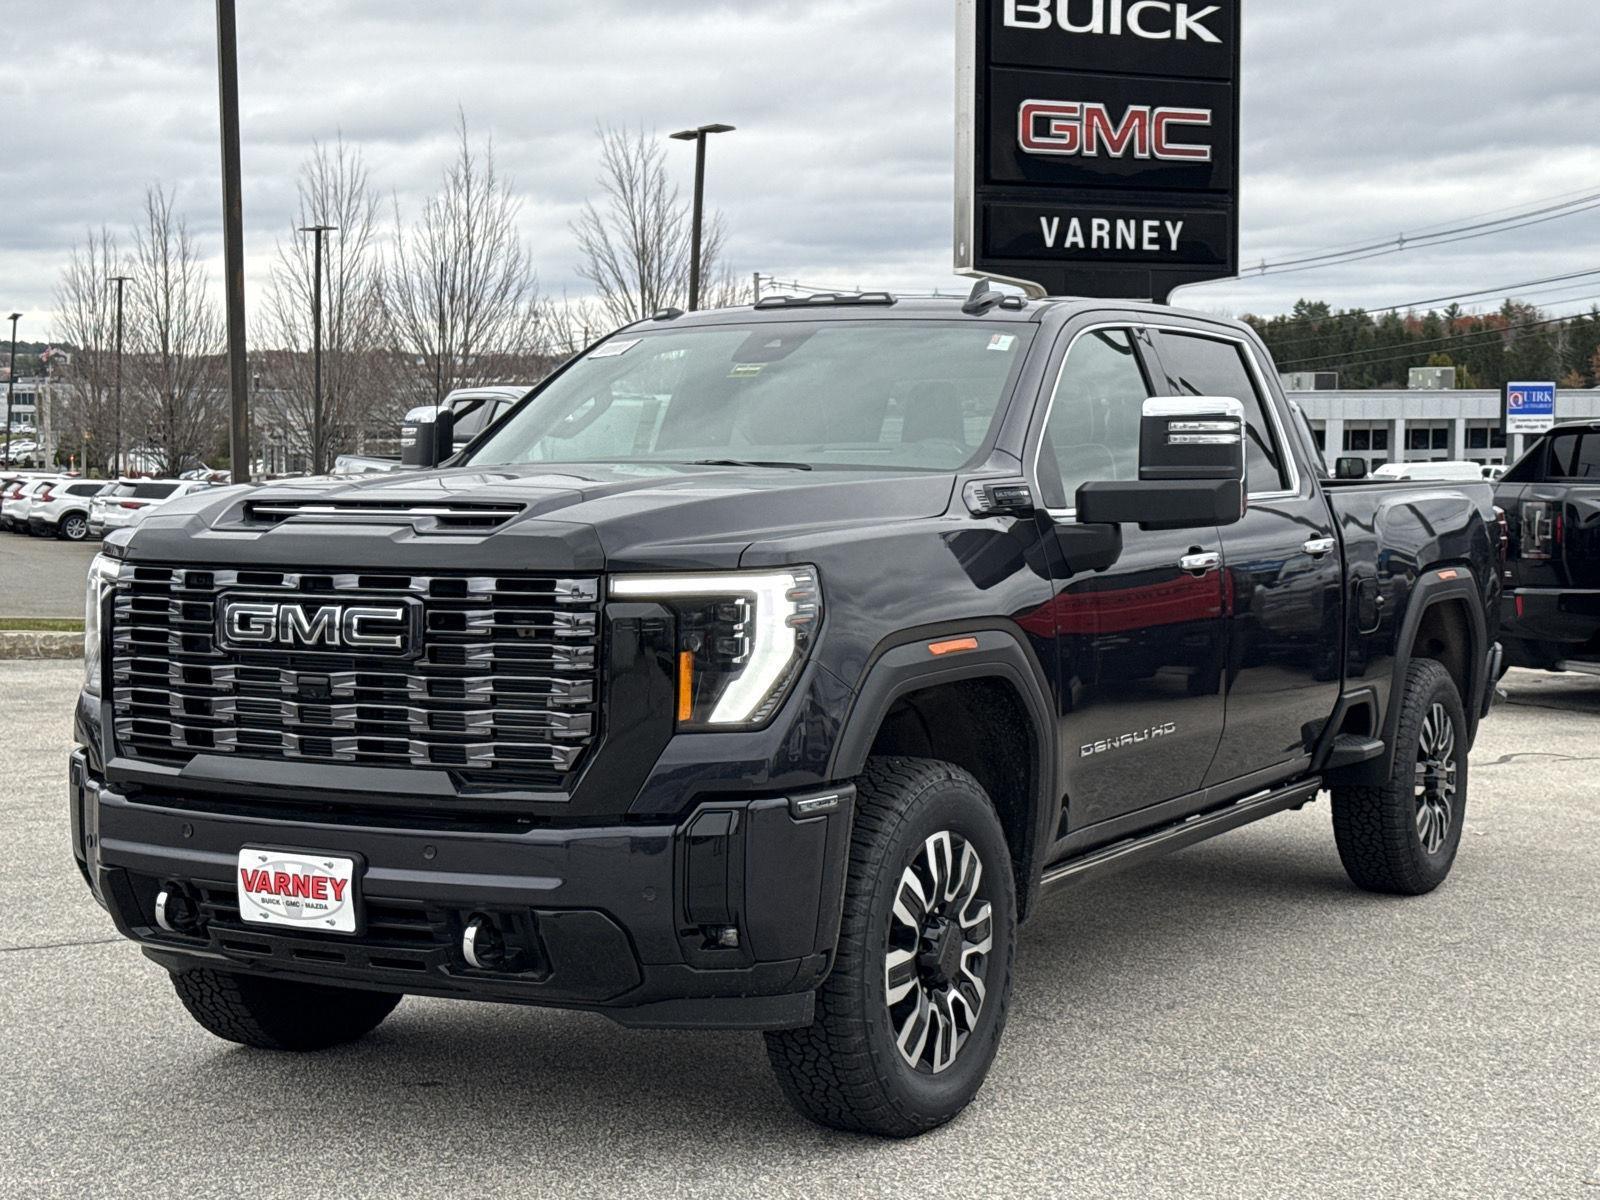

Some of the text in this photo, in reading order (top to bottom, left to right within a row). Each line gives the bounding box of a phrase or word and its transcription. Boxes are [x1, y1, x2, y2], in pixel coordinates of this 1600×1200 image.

[1003, 0, 1223, 43] BUICK
[1018, 99, 1212, 161] GMC
[1040, 216, 1184, 251] VARNEY
[225, 603, 403, 648] GMC
[1080, 721, 1176, 758] DENALI HD
[240, 868, 349, 902] VARNEY
[261, 897, 329, 910] BUICK GMC MAZDA
